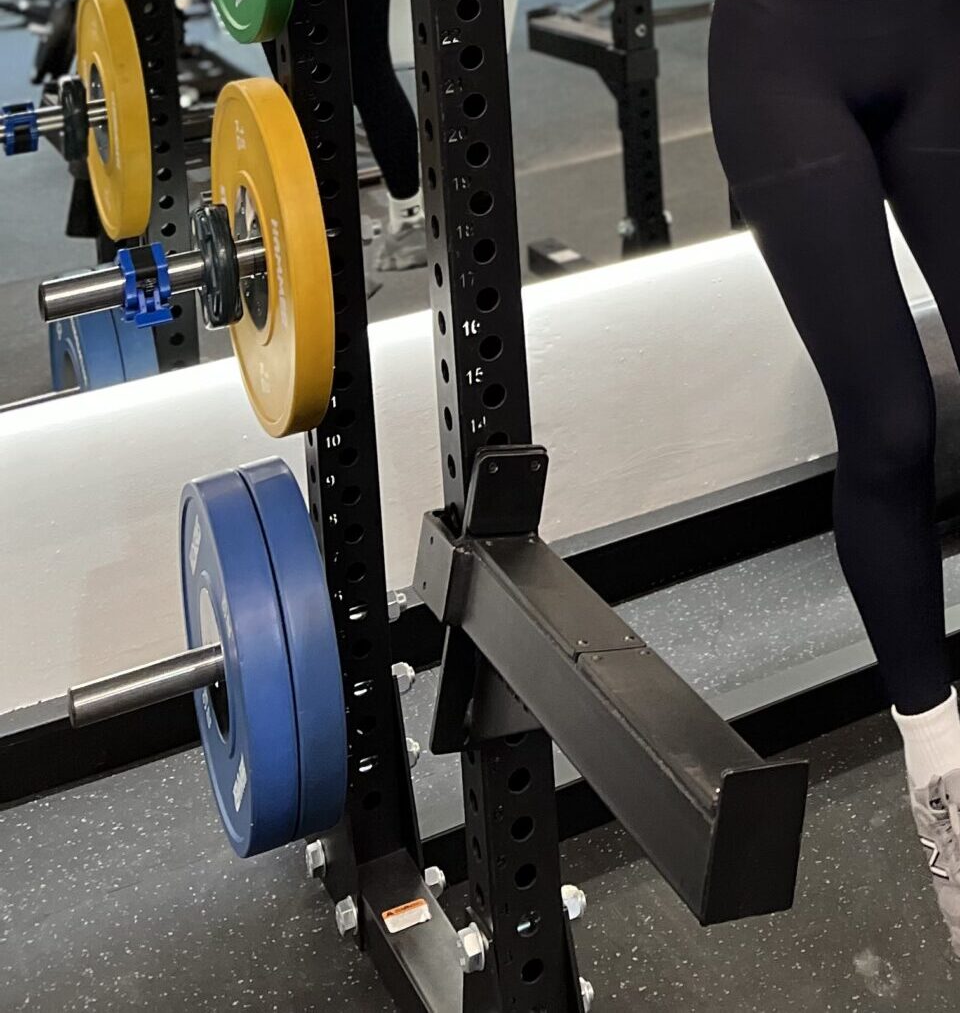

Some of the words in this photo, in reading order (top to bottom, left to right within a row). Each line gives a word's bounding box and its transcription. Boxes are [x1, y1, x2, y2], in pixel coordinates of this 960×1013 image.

[462, 319, 480, 336] 16
[466, 367, 483, 385] 15
[326, 434, 340, 448] 10
